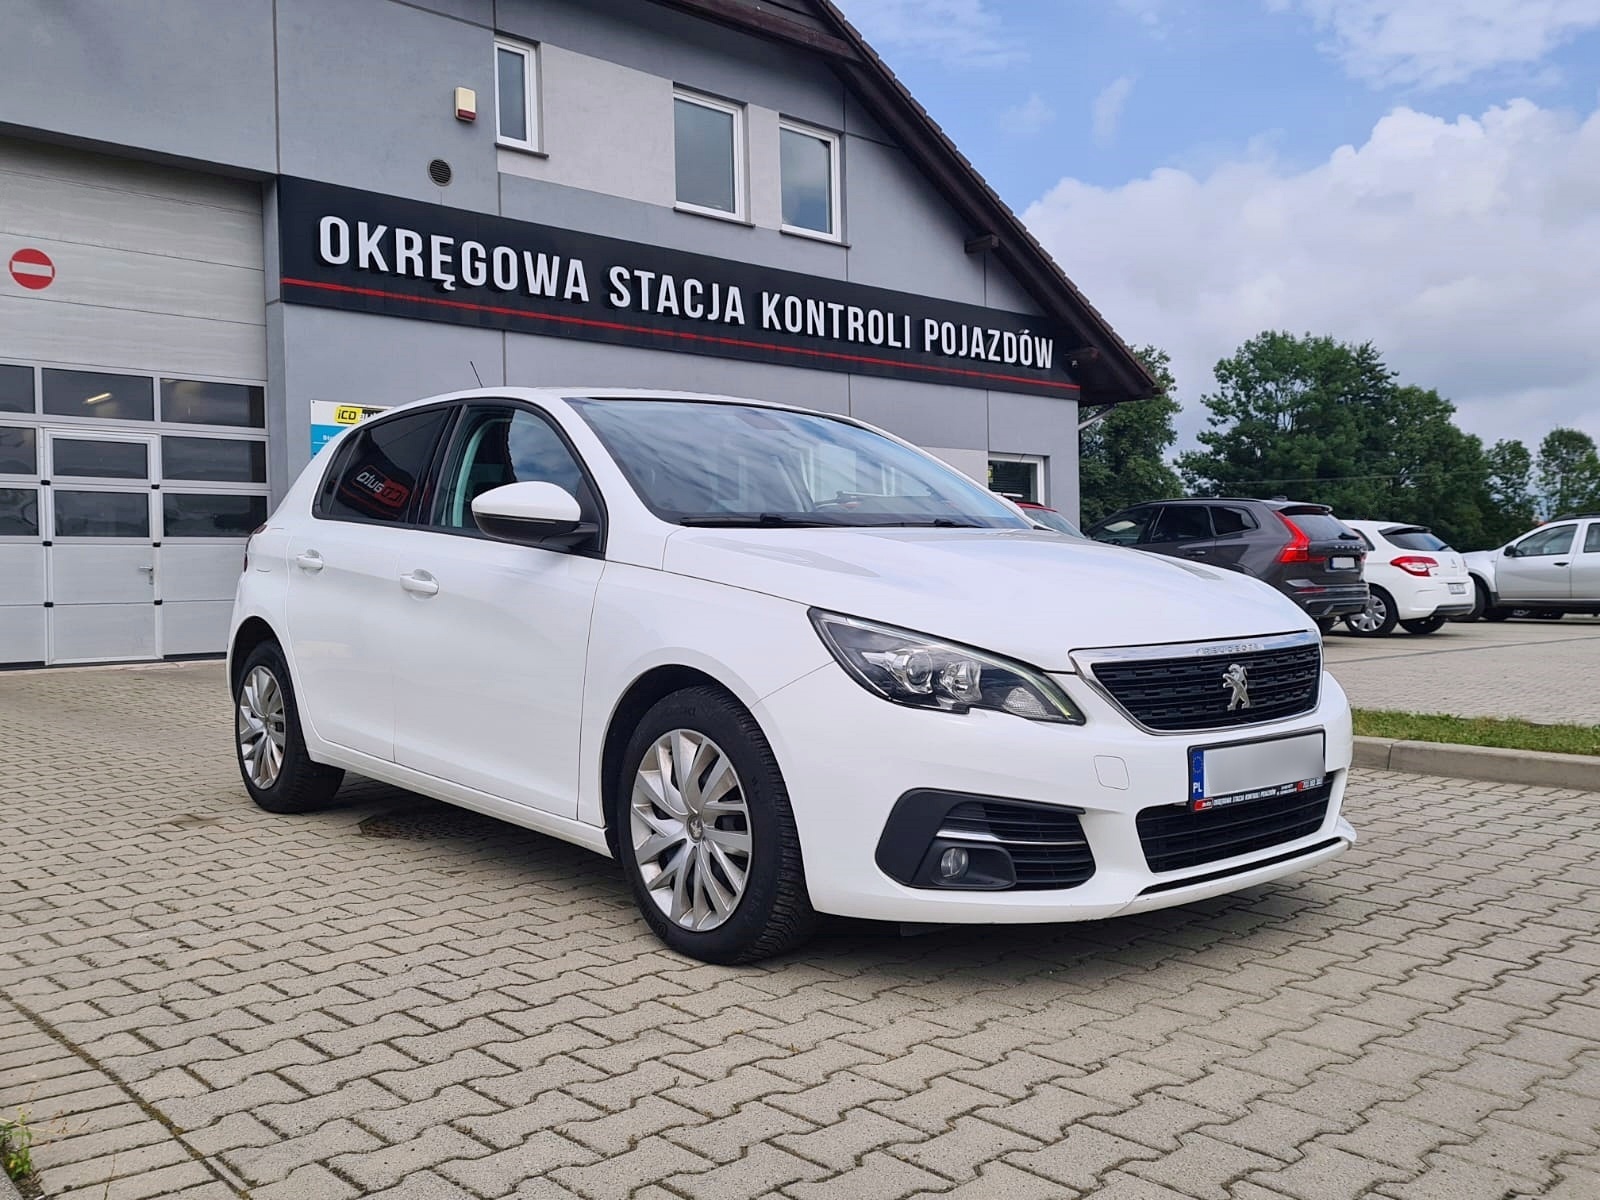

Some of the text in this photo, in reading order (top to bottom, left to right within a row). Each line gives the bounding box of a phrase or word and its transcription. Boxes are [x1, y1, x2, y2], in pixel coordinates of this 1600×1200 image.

[319, 215, 1054, 369] OKRĘGOWA STACJA KONTROLI POJAZDÓW
[1193, 782, 1203, 793] PL
